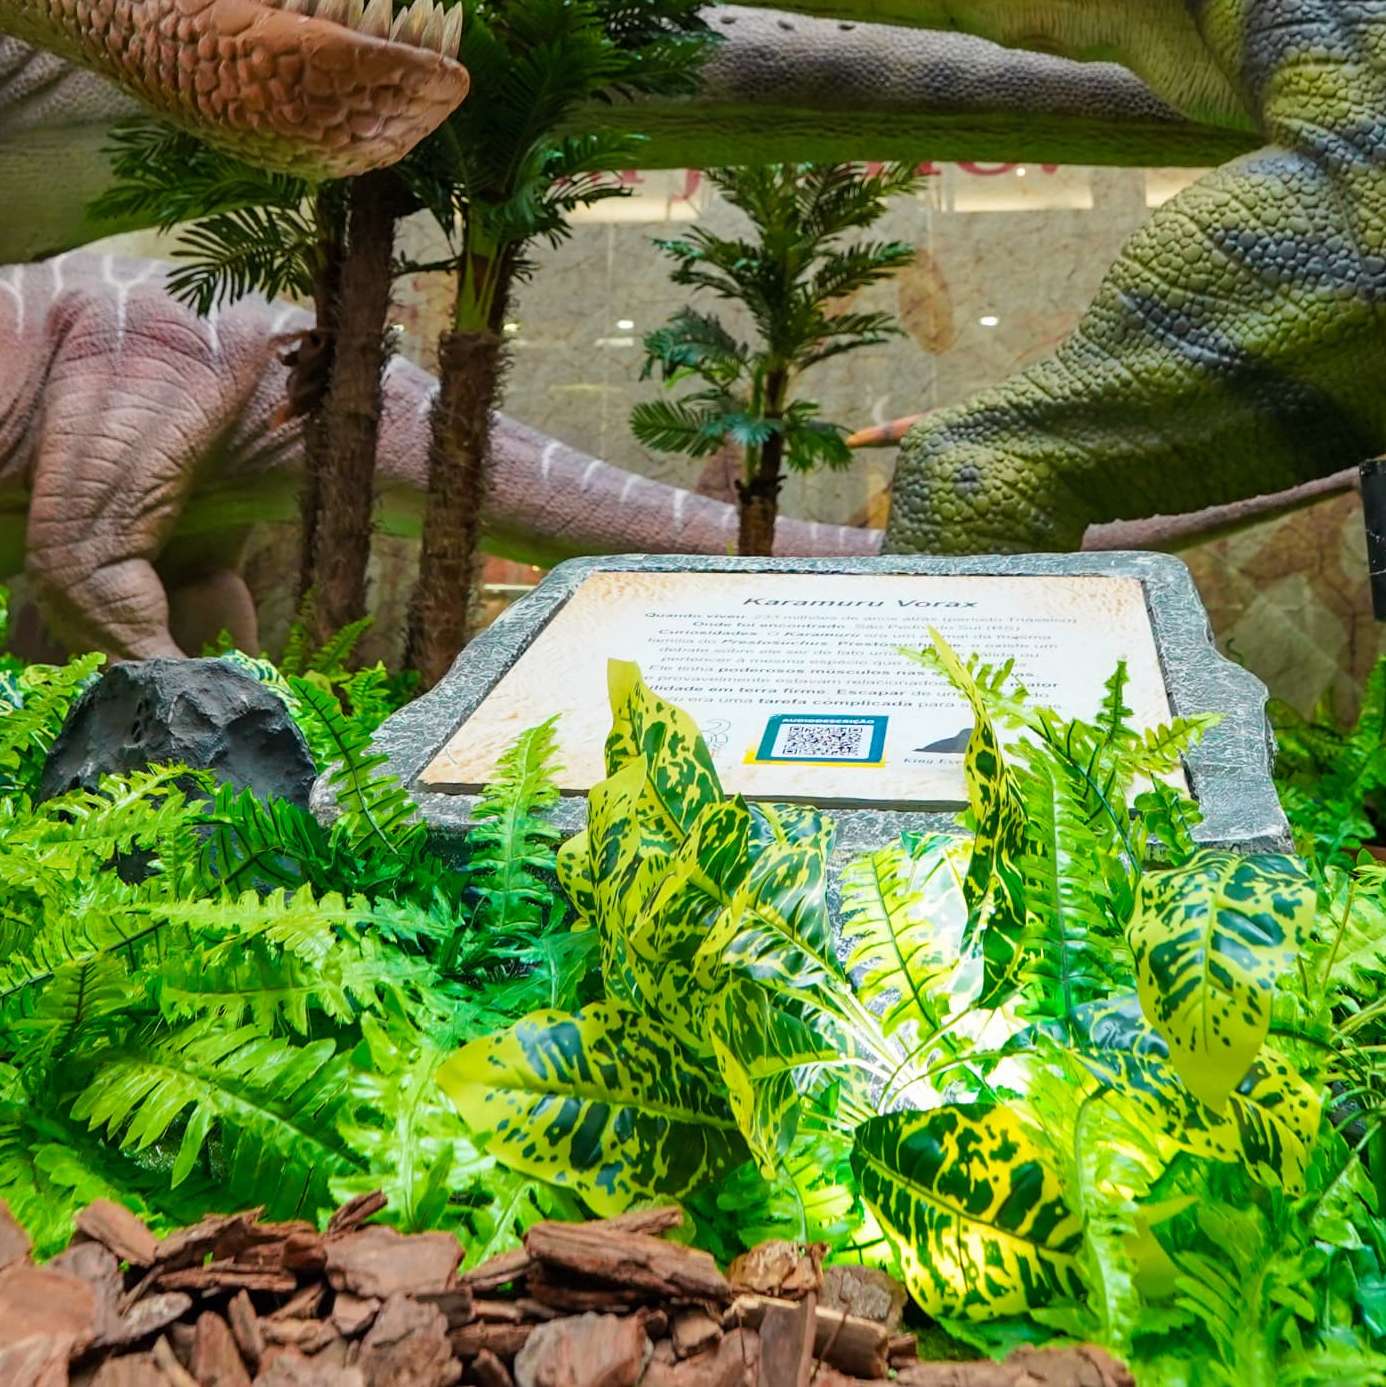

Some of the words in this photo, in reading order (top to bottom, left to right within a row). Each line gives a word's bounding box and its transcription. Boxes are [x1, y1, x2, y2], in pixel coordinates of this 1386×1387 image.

[742, 597, 884, 607] Karamuru
[897, 599, 979, 609] Vorax
[784, 631, 860, 639] Karamuru
[718, 666, 804, 674] poderosos
[739, 686, 777, 694] terra
[836, 688, 905, 697] Escapar
[758, 697, 807, 705] tarefa
[812, 699, 913, 708] complicada
